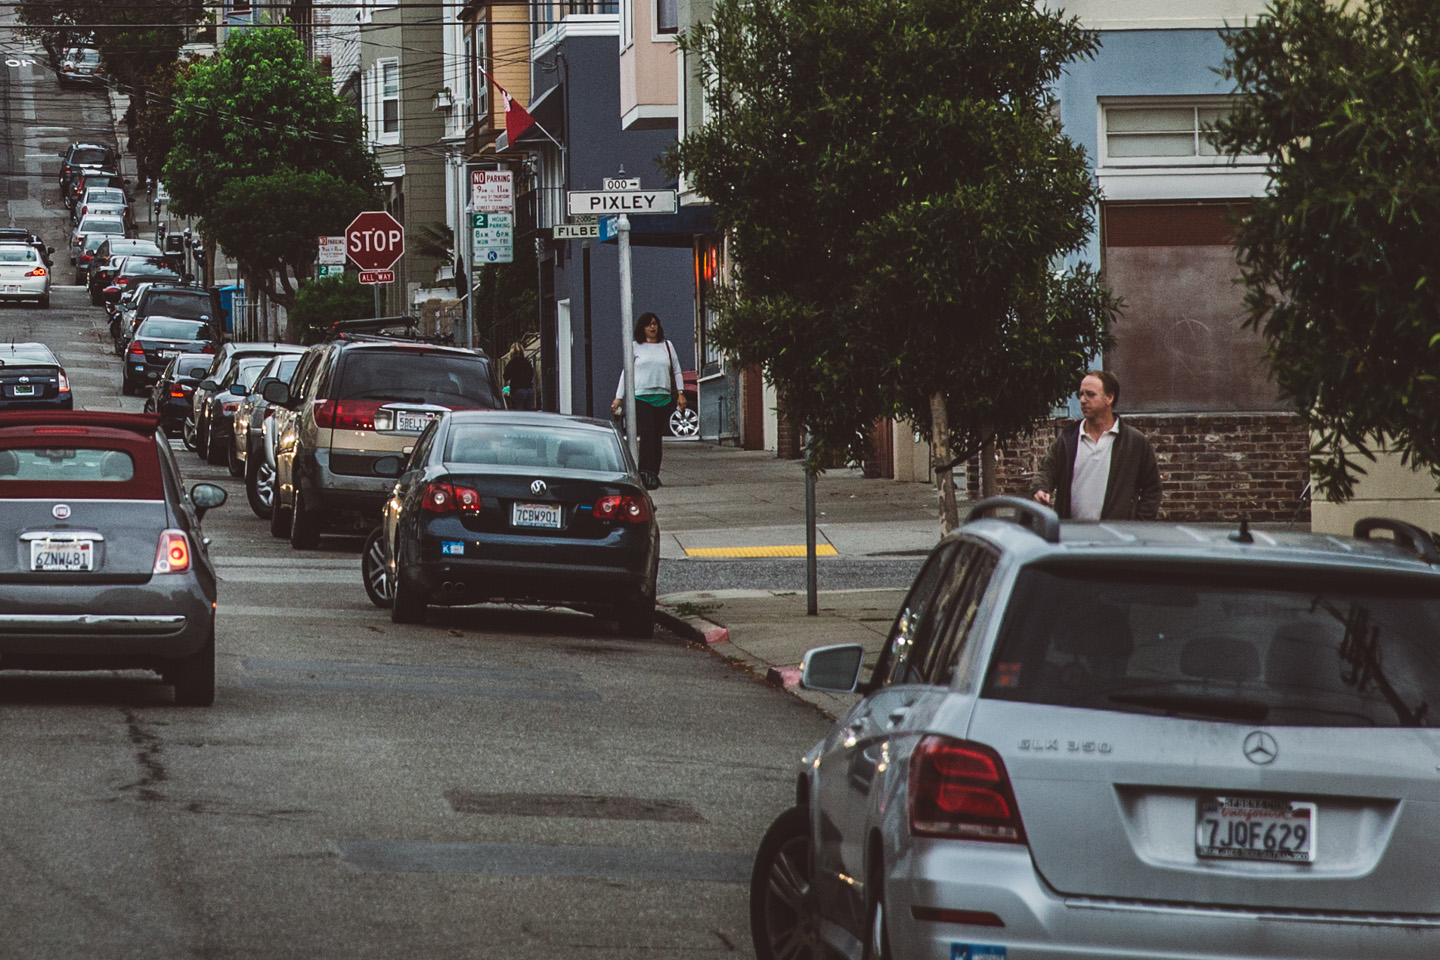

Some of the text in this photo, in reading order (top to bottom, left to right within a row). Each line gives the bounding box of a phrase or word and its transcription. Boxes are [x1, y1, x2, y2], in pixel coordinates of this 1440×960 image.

[473, 172, 510, 183] NO PARKING
[607, 180, 627, 190] 000
[590, 194, 656, 210] PIXLEY
[476, 215, 484, 225] 2
[350, 230, 401, 252] STOP
[321, 266, 327, 274] 2
[377, 273, 391, 281] WAY
[517, 509, 558, 522] 7CBW901
[35, 552, 86, 565] 6ZNW481
[1018, 739, 1112, 753] GLK 350
[1205, 819, 1307, 850] 7JQF629
